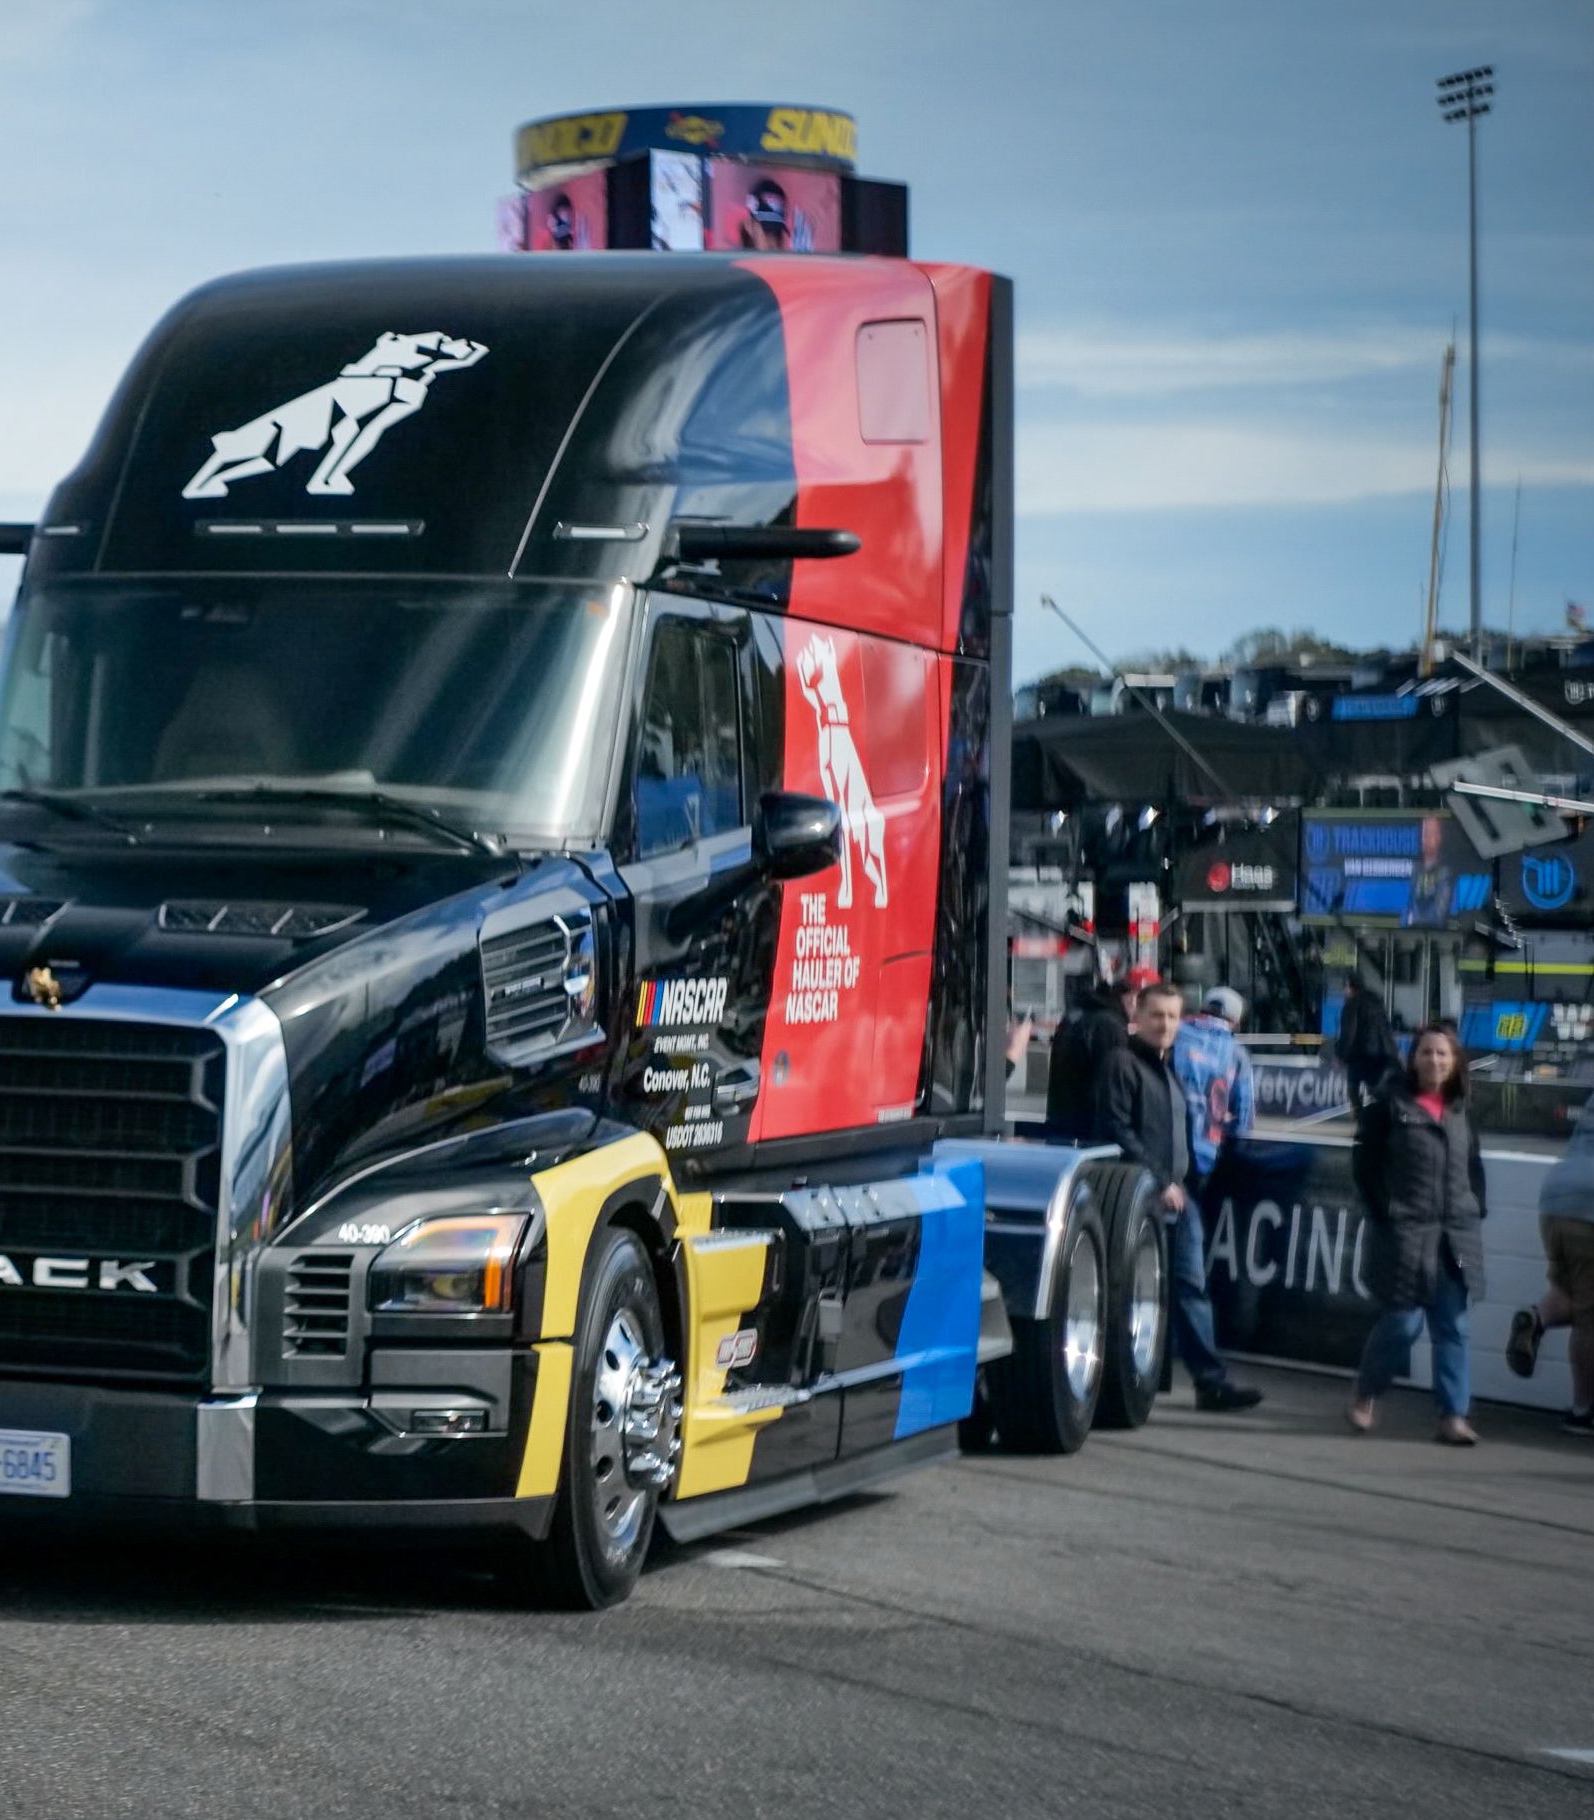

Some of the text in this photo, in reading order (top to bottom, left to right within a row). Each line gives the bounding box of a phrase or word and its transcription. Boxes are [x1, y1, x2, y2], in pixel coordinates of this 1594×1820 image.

[800, 892, 826, 926] THE
[795, 924, 851, 960] OFFICIAL
[792, 955, 860, 993] HAULER OF
[659, 976, 727, 1027] NASCAR
[785, 990, 839, 1025] NASCAR
[643, 1062, 711, 1094] Conover, N.C.
[666, 1123, 695, 1150] USDOT
